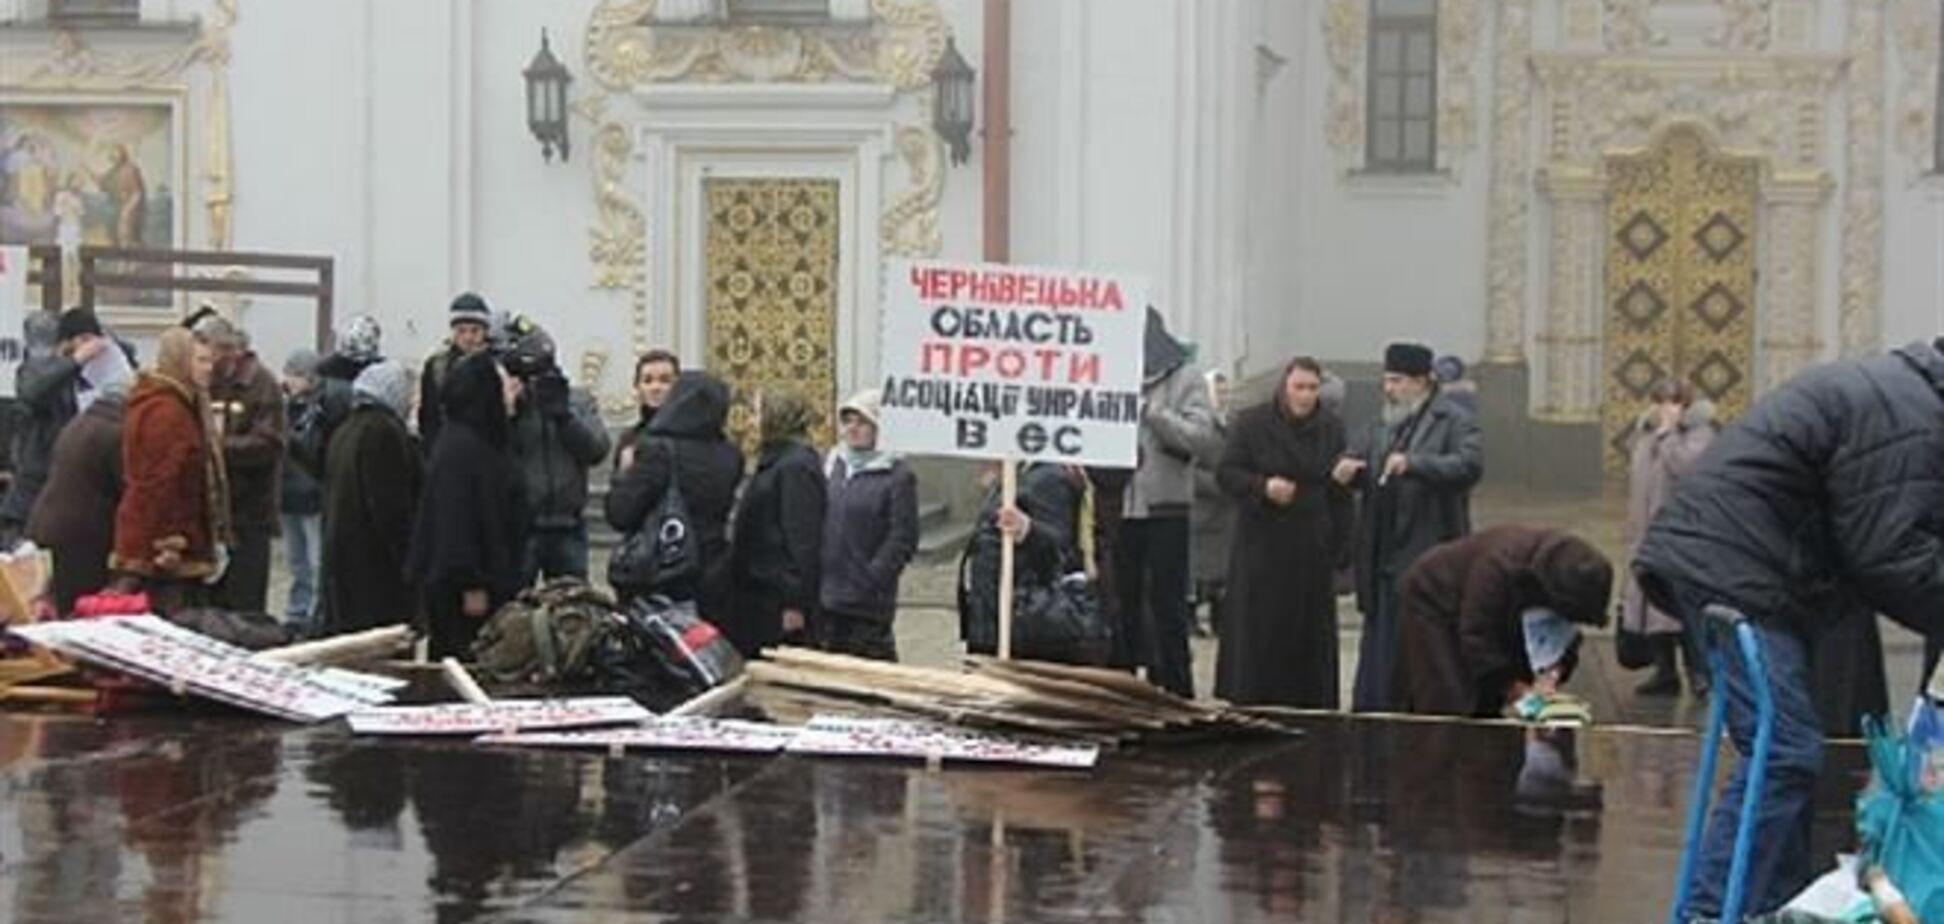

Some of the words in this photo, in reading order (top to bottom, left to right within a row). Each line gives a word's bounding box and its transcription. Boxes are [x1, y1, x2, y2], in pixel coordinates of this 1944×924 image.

[931, 305, 1093, 345] ОБЛАСТЬ
[921, 343, 1099, 383] ПРОТИ
[956, 418, 987, 449] В
